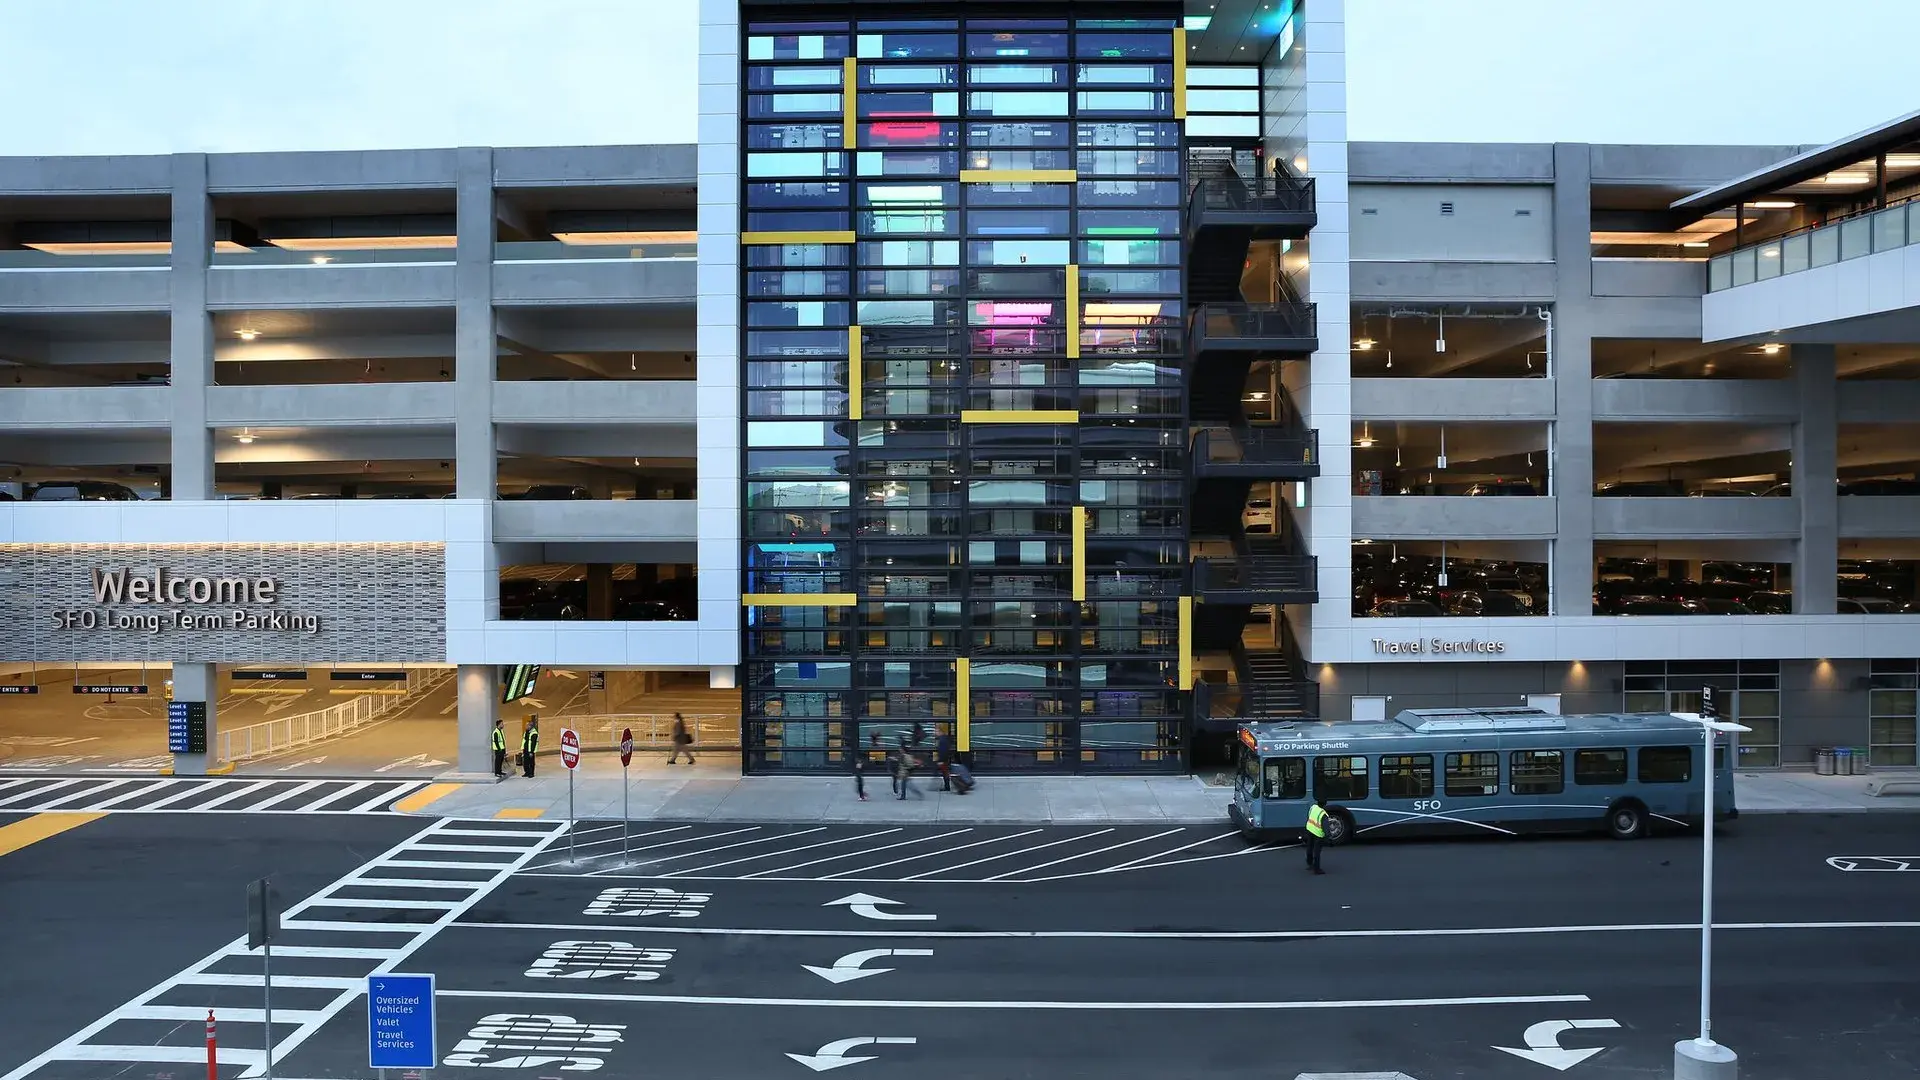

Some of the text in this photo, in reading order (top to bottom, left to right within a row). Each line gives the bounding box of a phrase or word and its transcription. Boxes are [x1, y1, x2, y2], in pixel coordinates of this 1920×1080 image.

[91, 567, 276, 603] Welcome
[51, 610, 318, 633] SFO Long-Term Parking
[1372, 638, 1505, 653] Travel Services
[621, 738, 633, 757] STOP
[1292, 743, 1319, 751] Parking
[564, 753, 576, 762] ENTER
[1414, 800, 1441, 810] SFO
[376, 996, 419, 1004] Oversized
[377, 1005, 413, 1013] Vehicles
[377, 1018, 399, 1026] Valet
[377, 1031, 404, 1039] Travel
[377, 1040, 414, 1048] Services
